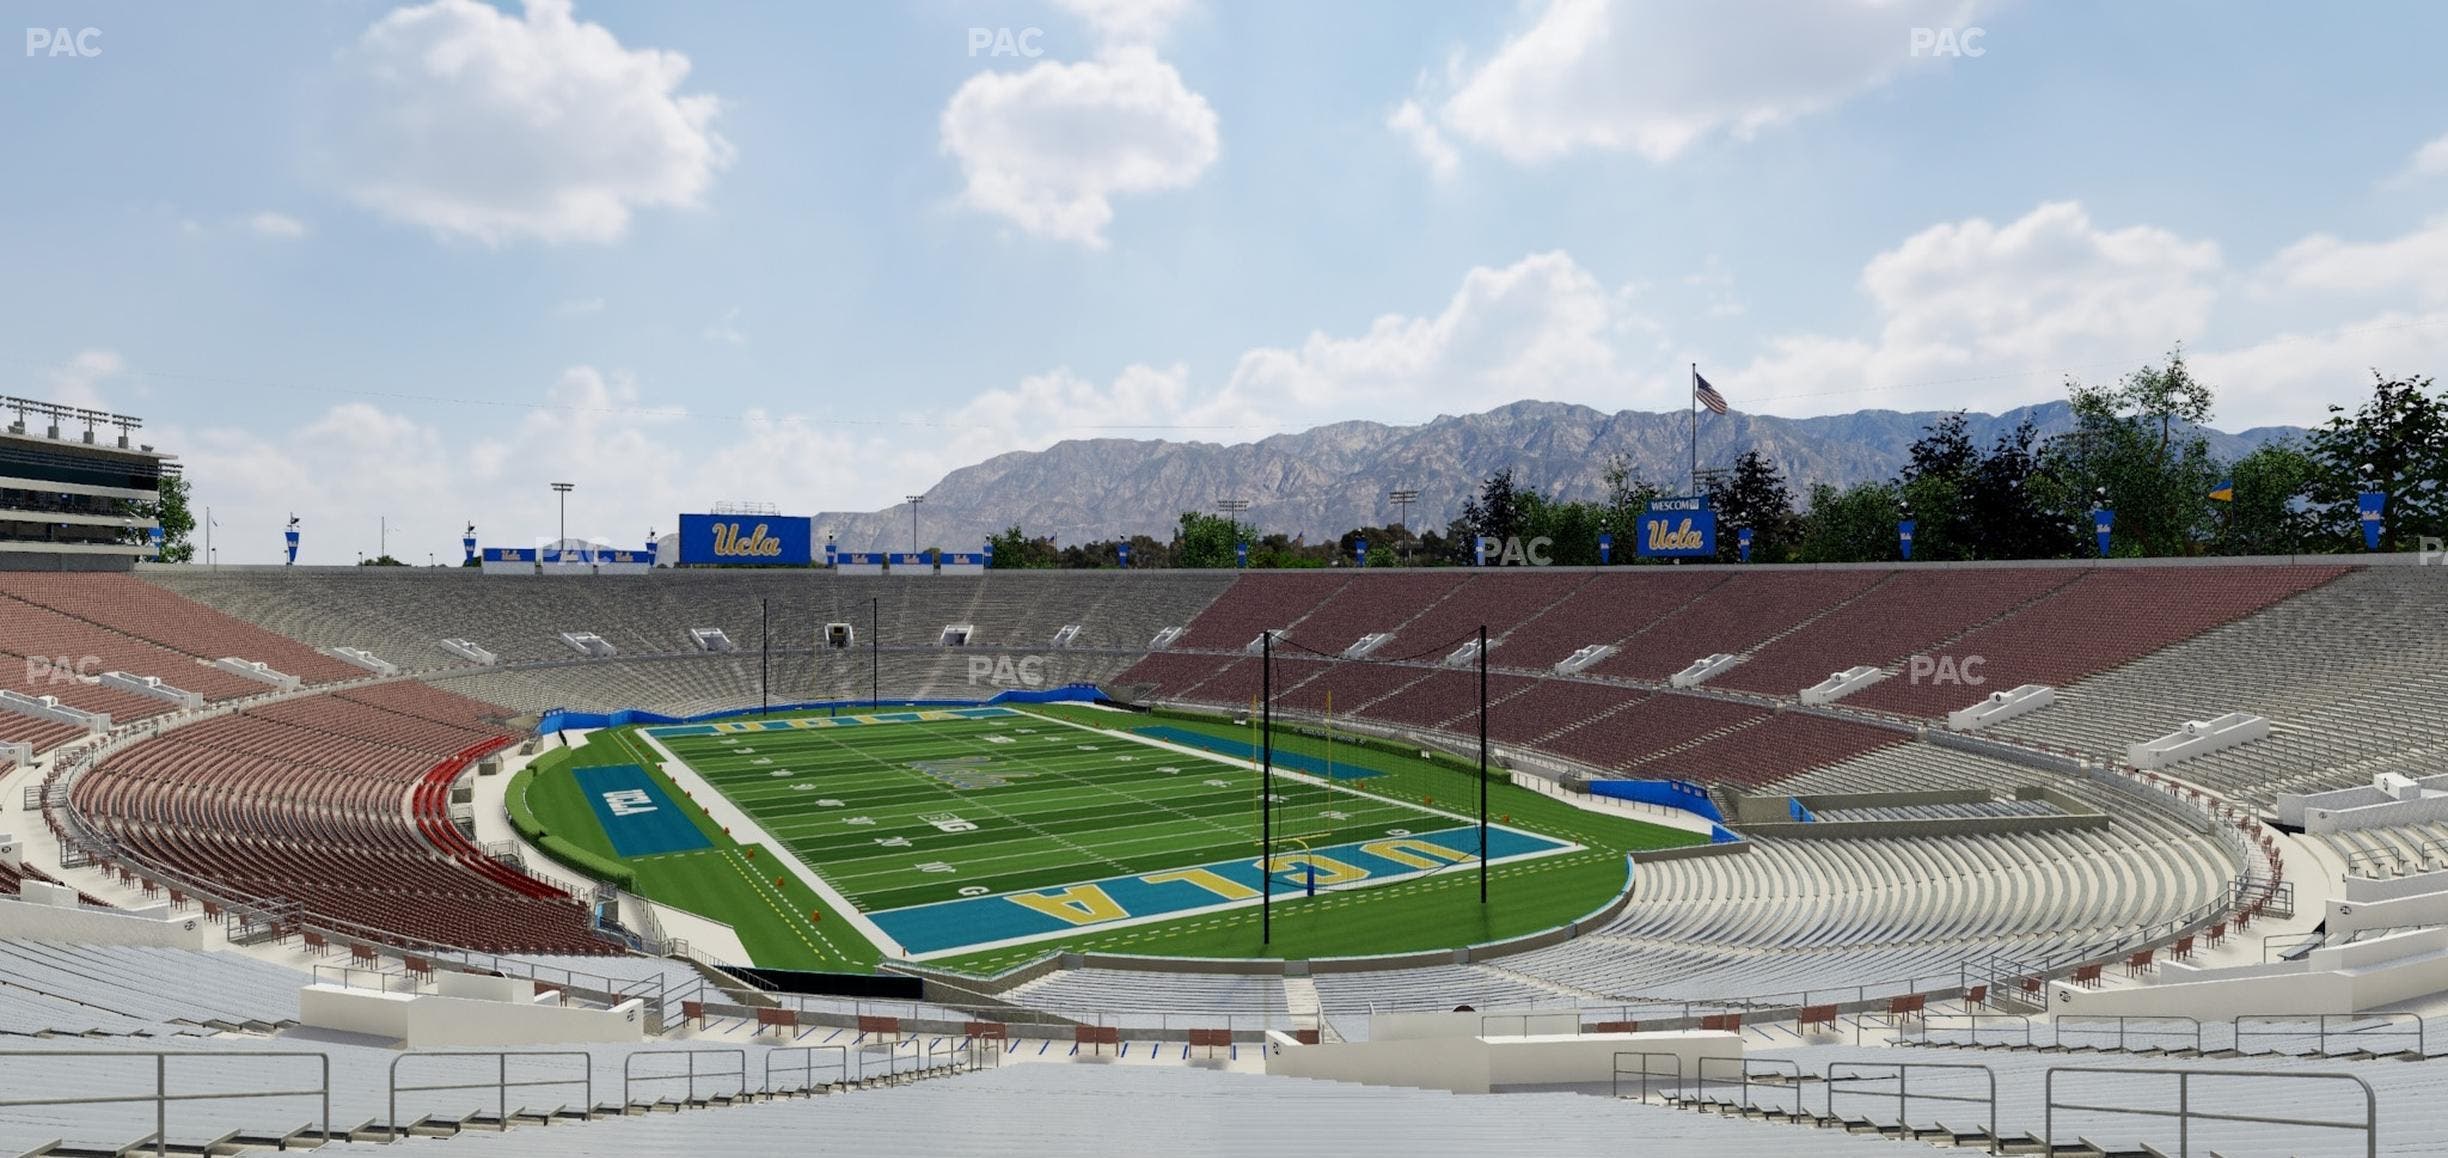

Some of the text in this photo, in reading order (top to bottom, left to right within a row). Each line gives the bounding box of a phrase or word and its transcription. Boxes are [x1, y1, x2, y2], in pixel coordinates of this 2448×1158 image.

[1651, 500, 1690, 511] WESCOM
[712, 523, 782, 556] Ucla
[1648, 518, 1704, 549] Ucla
[1003, 839, 1478, 926] UCLA
